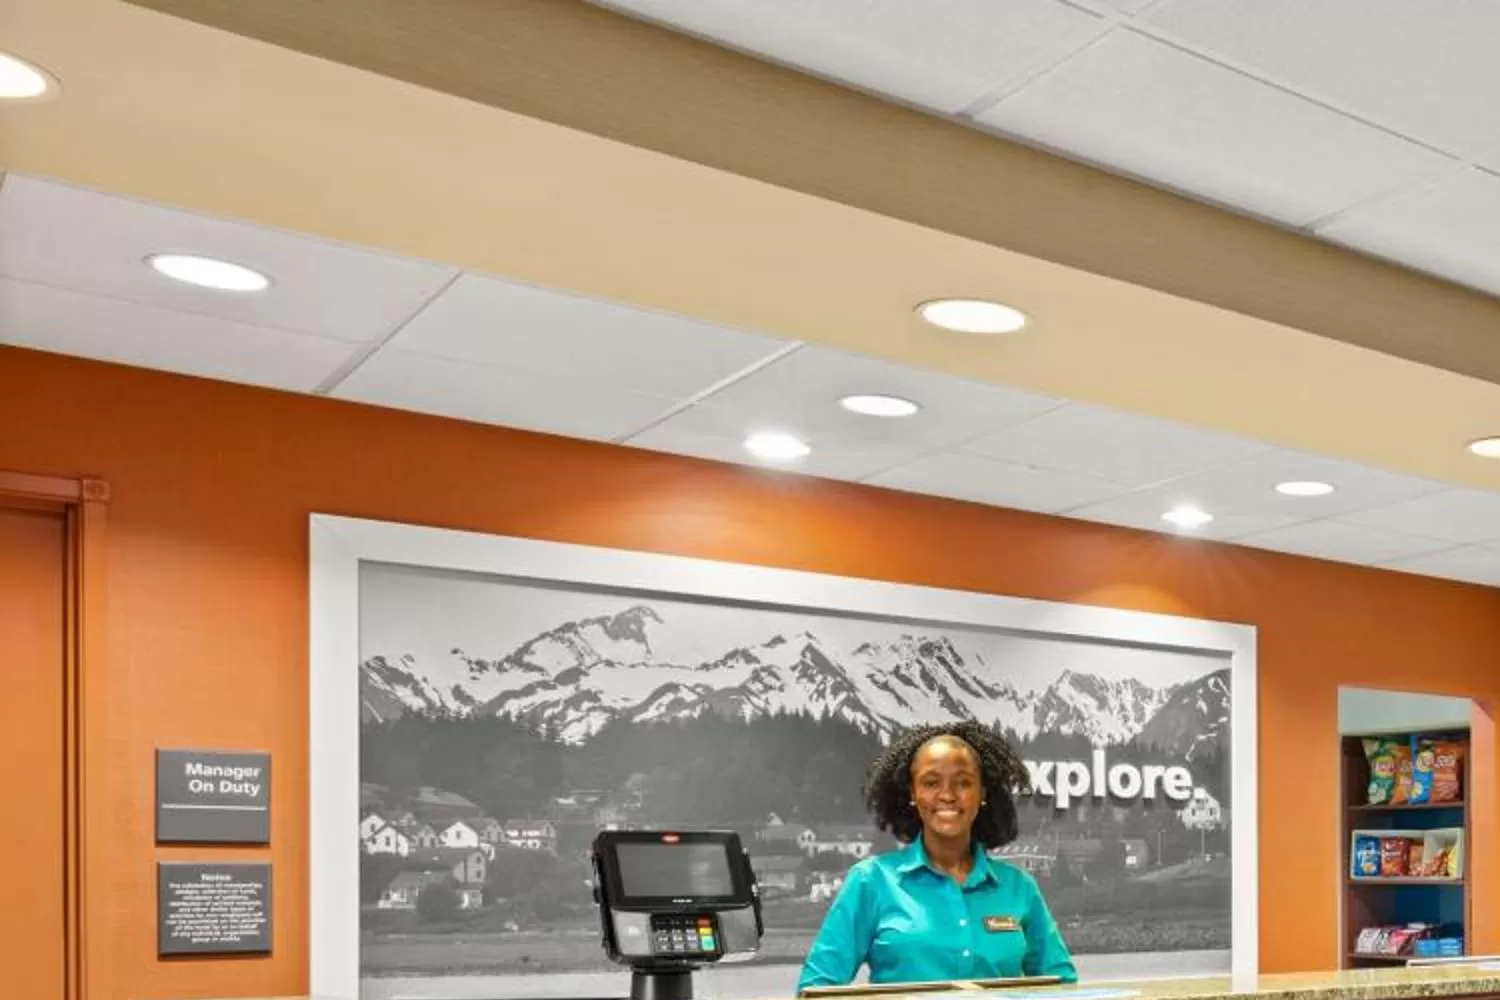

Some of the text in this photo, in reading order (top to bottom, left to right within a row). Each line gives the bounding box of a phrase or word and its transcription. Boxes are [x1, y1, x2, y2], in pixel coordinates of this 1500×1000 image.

[184, 762, 262, 781] Manager
[1011, 749, 1206, 809] xplore.
[188, 779, 261, 797] On Duty
